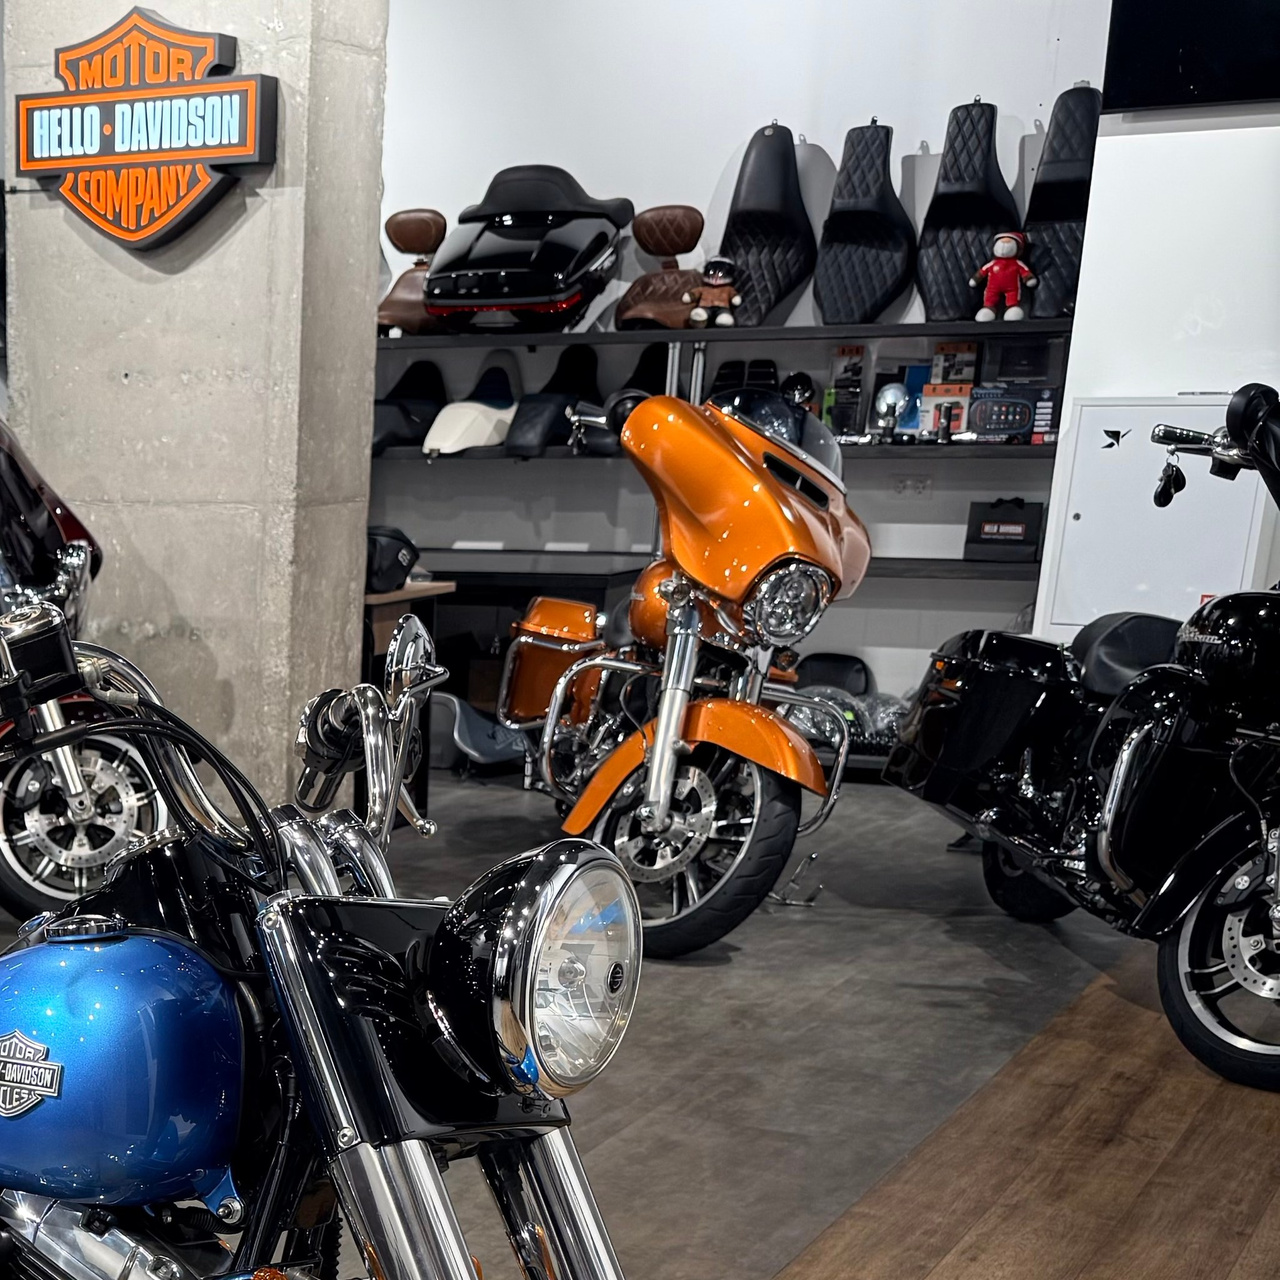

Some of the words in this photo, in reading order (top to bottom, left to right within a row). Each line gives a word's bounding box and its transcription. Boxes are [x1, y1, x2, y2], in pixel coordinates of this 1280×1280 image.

[79, 30, 192, 89] MOTOR
[33, 106, 100, 158] HELLO
[114, 94, 240, 152] DAVIDSON
[77, 164, 193, 229] COMPANY
